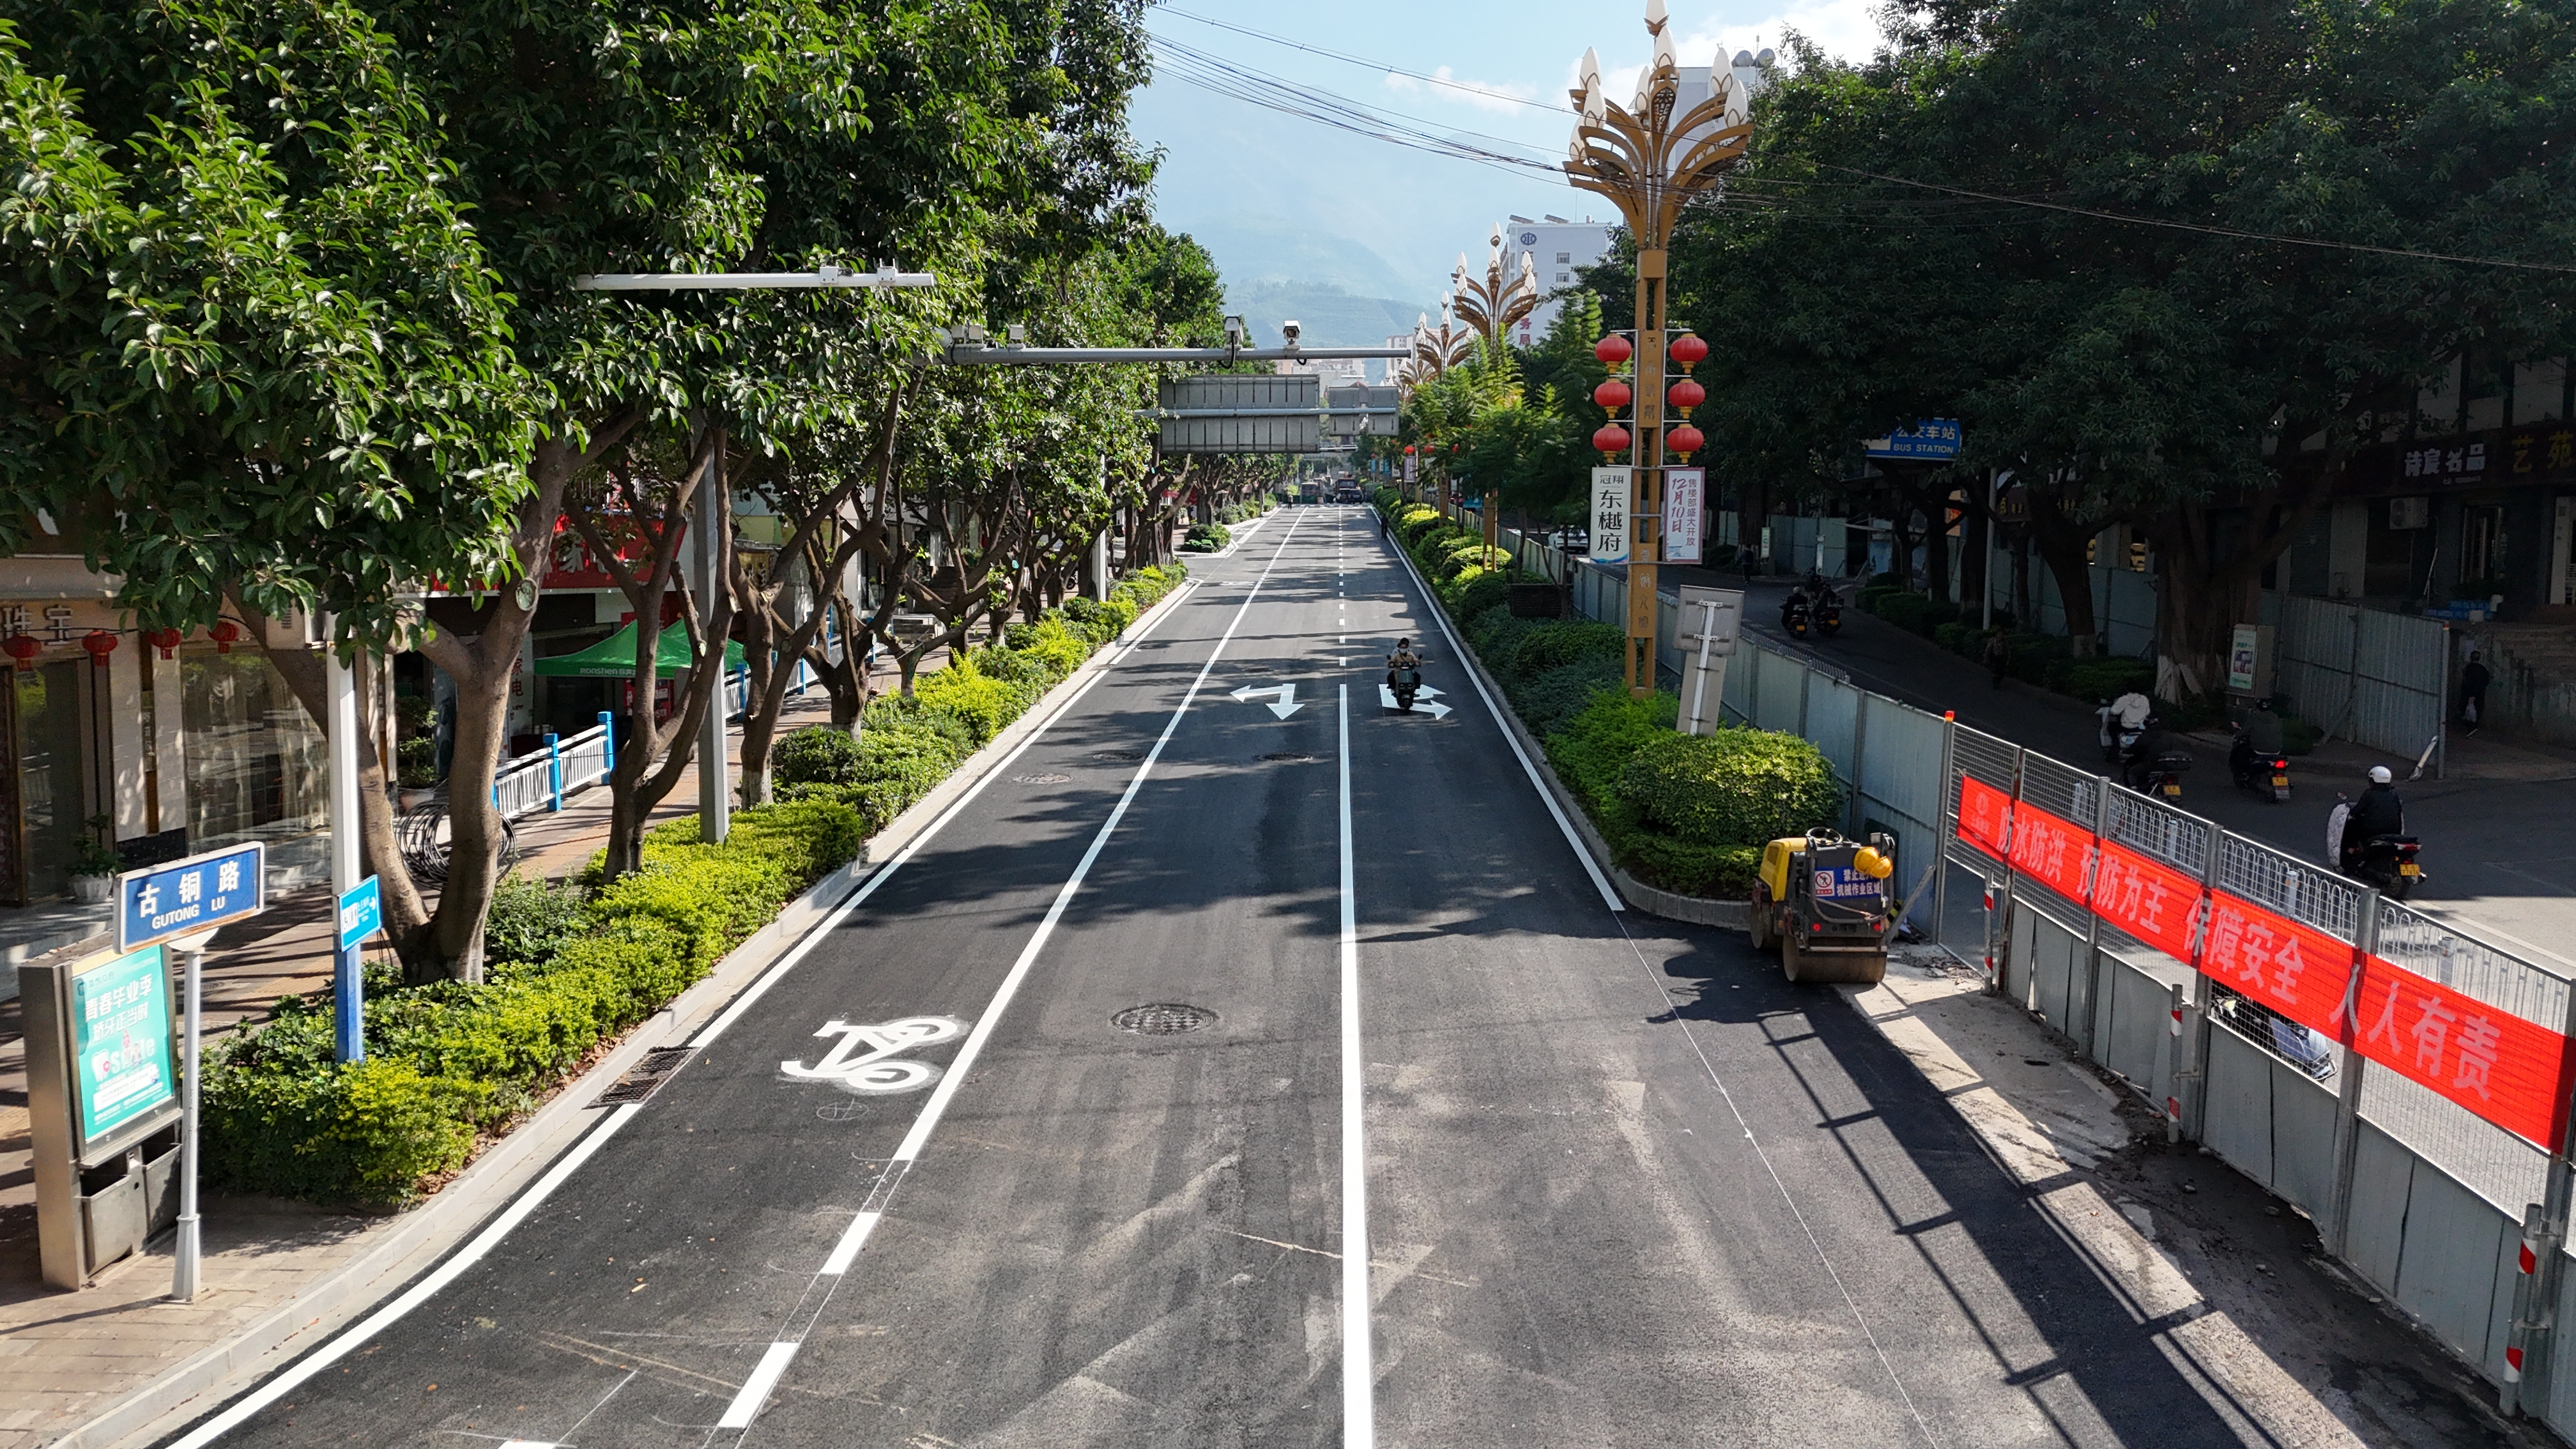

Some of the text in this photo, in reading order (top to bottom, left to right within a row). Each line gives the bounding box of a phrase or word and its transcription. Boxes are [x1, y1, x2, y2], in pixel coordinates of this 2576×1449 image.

[1893, 443, 1954, 454] BUS STATION
[1896, 425, 1956, 440] 公交车站
[1599, 475, 1624, 484] 冠翔
[1597, 489, 1623, 552] 东樾府
[1685, 478, 1698, 546] 售楼部盛大开放
[511, 650, 523, 696] 家电
[579, 667, 618, 675] Ronshen
[137, 860, 240, 918] 古铜路
[1836, 882, 1881, 897] 机械作业区域
[152, 896, 226, 930] GUTONG LU
[2076, 842, 2168, 935] 预防为主
[2184, 893, 2305, 1006] 保障安全
[2329, 963, 2501, 1103] 人人有责
[84, 973, 153, 1021] 青春毕业季
[93, 1001, 149, 1043] 矫牙正当时
[110, 1038, 156, 1074] smle
